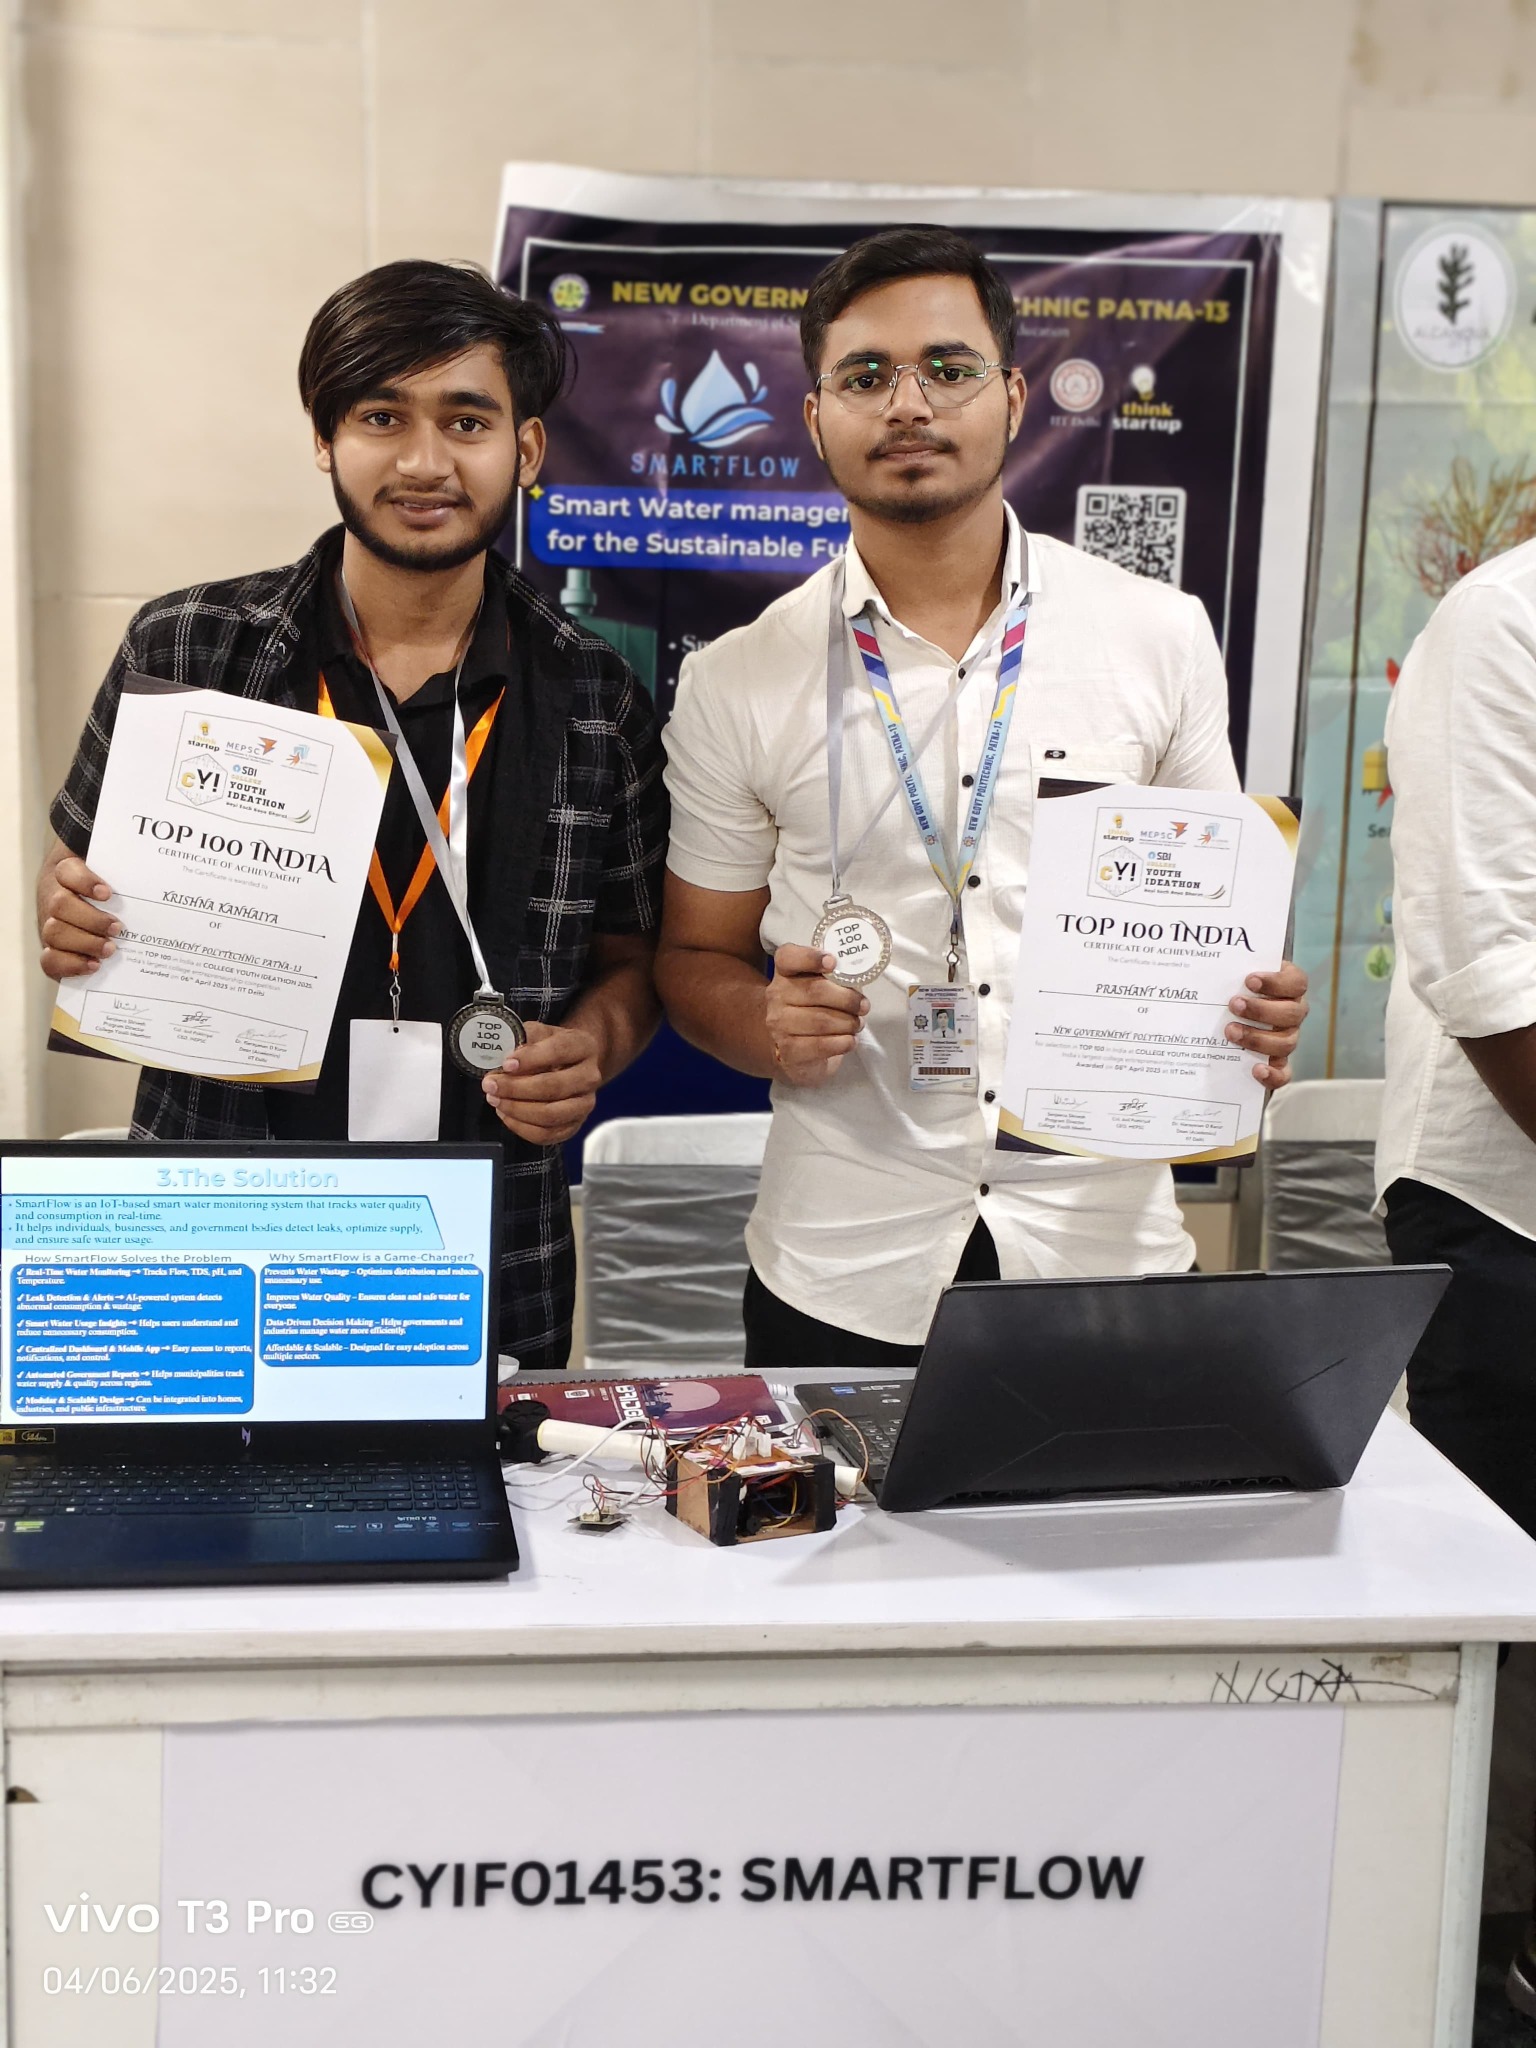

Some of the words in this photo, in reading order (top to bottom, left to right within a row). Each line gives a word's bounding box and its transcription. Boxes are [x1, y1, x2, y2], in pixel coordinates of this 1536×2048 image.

[612, 282, 682, 303] NEW
[690, 285, 808, 308] GOVERN
[1098, 299, 1229, 323] PATNA-13
[1122, 402, 1173, 417] think
[1112, 417, 1182, 434] startup
[631, 453, 800, 477] SMARTFLOW
[548, 495, 631, 516] Smart
[639, 497, 723, 519] Water
[547, 529, 586, 551] for
[594, 531, 639, 552] the
[646, 533, 803, 557] Sustainable
[225, 741, 260, 755] MEPSC
[241, 766, 257, 777] SBI
[230, 781, 267, 796] YOUTH
[227, 791, 285, 810] IDEATHON
[918, 814, 930, 831] NEW
[1140, 830, 1173, 840] MEPSC
[132, 814, 193, 843] TOP
[200, 833, 243, 856] 100
[250, 840, 338, 883] INDIA
[1157, 852, 1172, 861] SBI
[158, 847, 217, 867] CERTIFICATE
[220, 860, 233, 869] OF
[235, 864, 301, 884] ACHIEVEMENT
[1146, 868, 1182, 878] YOUTH
[1145, 878, 1201, 889] IDEATHON
[163, 891, 214, 911] KRISHNA
[217, 903, 278, 924] KANHAIYA
[209, 921, 222, 930] OF
[835, 923, 860, 936] TOP
[1056, 914, 1115, 936] TOP
[1123, 922, 1163, 940] 100
[1170, 920, 1256, 952] INDIA
[119, 929, 139, 939] NEW
[140, 934, 200, 952] GOVERNMENT
[202, 946, 260, 965] POLYTECHNIC
[839, 933, 862, 946] 100
[838, 943, 869, 958] INDIA
[1084, 941, 1140, 953] CERTIFICATE
[1143, 946, 1154, 954] OF
[1157, 947, 1221, 959] ACHIEVEMENT
[1095, 983, 1157, 998] PRASHANT
[1158, 988, 1198, 1000] KUMAR
[1137, 1006, 1149, 1014] OF
[477, 1022, 502, 1030] TOP
[477, 1032, 500, 1040] 100
[1053, 1026, 1072, 1034] NEW
[1073, 1028, 1132, 1040] GOVERNMENT
[1133, 1033, 1188, 1044] POLYTECHNIC
[472, 1041, 503, 1051] INDIA
[233, 1167, 339, 1188] Solution
[15, 1199, 70, 1208] SmartFlow
[74, 1200, 83, 1208] is
[100, 1200, 150, 1208] IoT-based
[213, 1201, 268, 1212] monitoring
[271, 1202, 303, 1211] system
[306, 1201, 325, 1209] that
[328, 1201, 357, 1209] tracks
[360, 1201, 385, 1209] water
[389, 1201, 421, 1211] quality
[15, 1211, 34, 1220] and
[37, 1212, 101, 1222] consumption
[105, 1211, 115, 1220] in
[16, 1223, 24, 1232] It
[27, 1223, 52, 1234] helps
[55, 1223, 111, 1233] individuals,
[115, 1223, 167, 1233] businesses,
[169, 1223, 188, 1232] and
[191, 1224, 249, 1234] government
[252, 1223, 283, 1233] bodies
[285, 1223, 314, 1232] detect
[317, 1223, 343, 1234] leaks,
[346, 1224, 387, 1235] optimize
[390, 1224, 423, 1235] supply,
[15, 1235, 34, 1244] and
[37, 1236, 69, 1244] ensure
[72, 1234, 91, 1244] safe
[94, 1236, 121, 1244] water
[25, 1255, 50, 1263] How
[55, 1254, 118, 1263] SmartFlow
[121, 1254, 158, 1263] Solves
[161, 1254, 180, 1263] the
[184, 1254, 232, 1263] Problem
[270, 1253, 295, 1264] Why
[299, 1253, 359, 1262] SmartFlow
[363, 1253, 371, 1262] is
[384, 1253, 474, 1264] Game-Changer?
[615, 1384, 646, 1420] BRIDG
[360, 1858, 722, 1910] CYIF01453:
[740, 1854, 1146, 1904] SMARTFLOW
